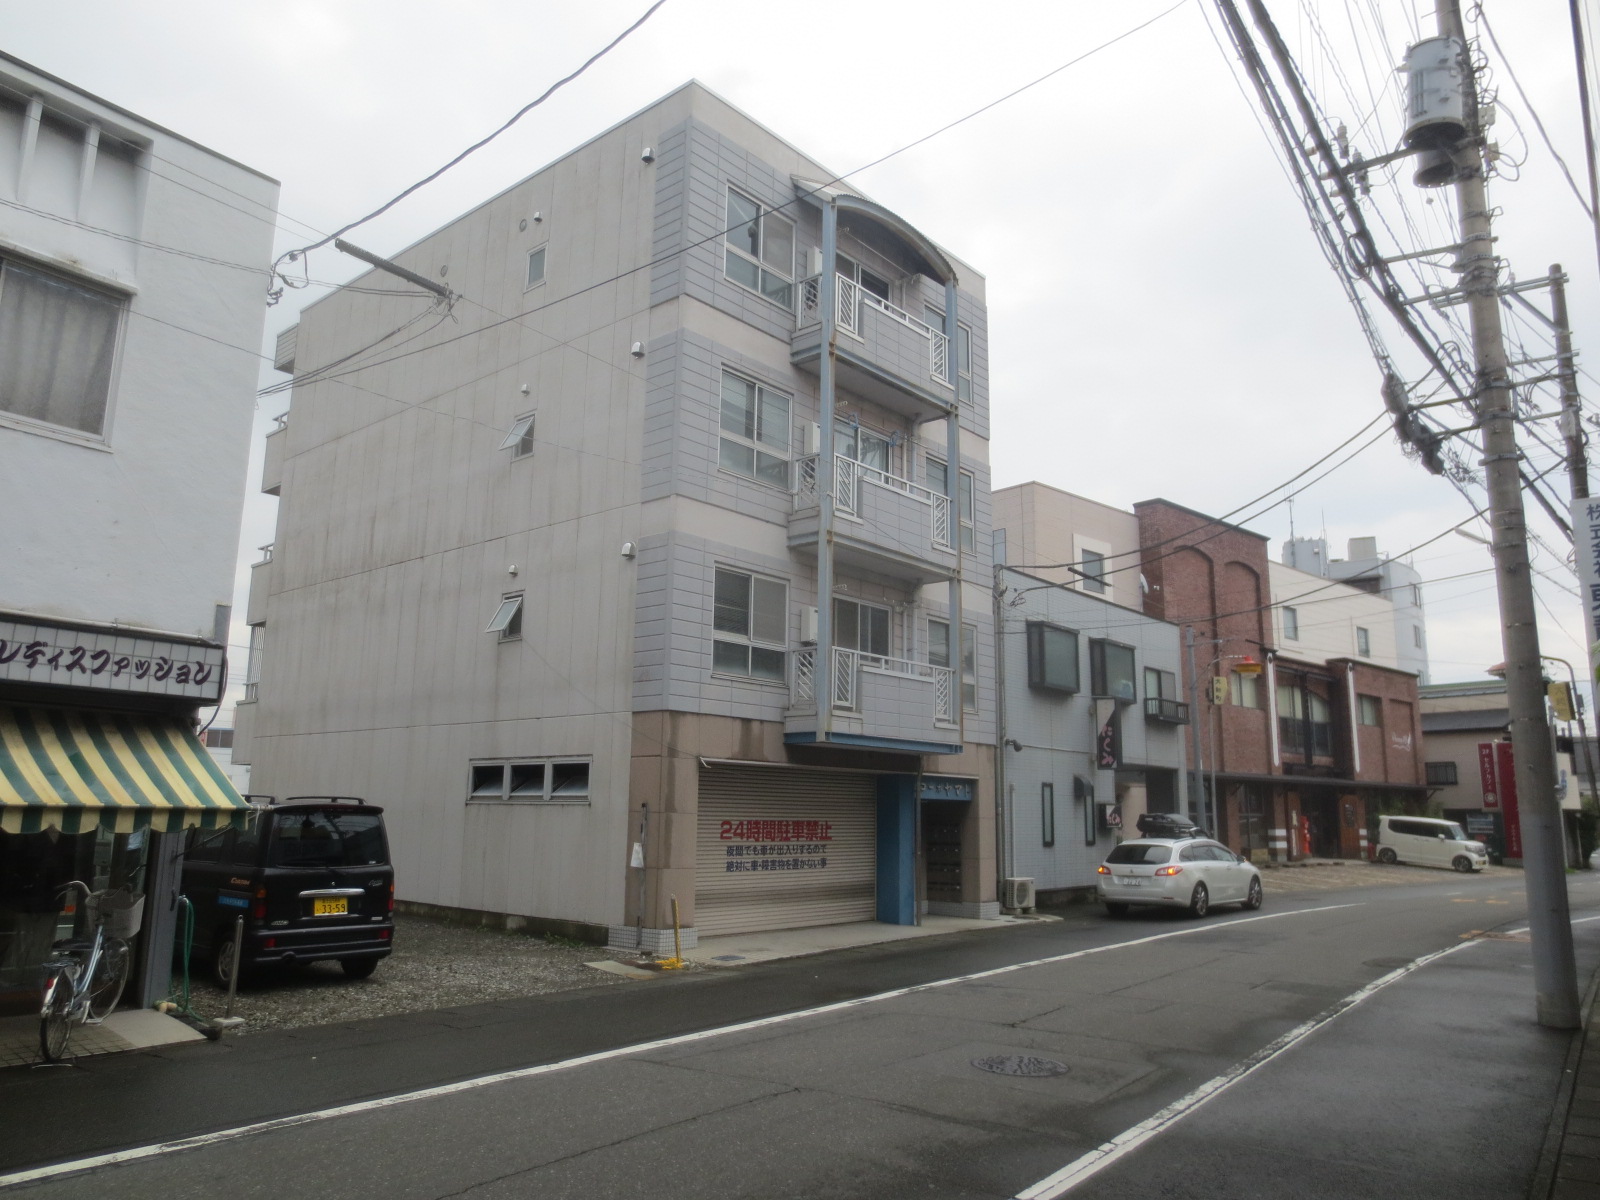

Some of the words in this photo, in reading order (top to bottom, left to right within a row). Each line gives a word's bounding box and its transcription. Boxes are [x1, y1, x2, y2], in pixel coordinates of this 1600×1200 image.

[0, 638, 212, 686] レディスファッション
[1101, 724, 1114, 766] たくみ
[719, 819, 833, 842] 24時間駐車禁止
[726, 843, 828, 858] 夜間でも車が出入りするので
[322, 903, 346, 914] 33-59
